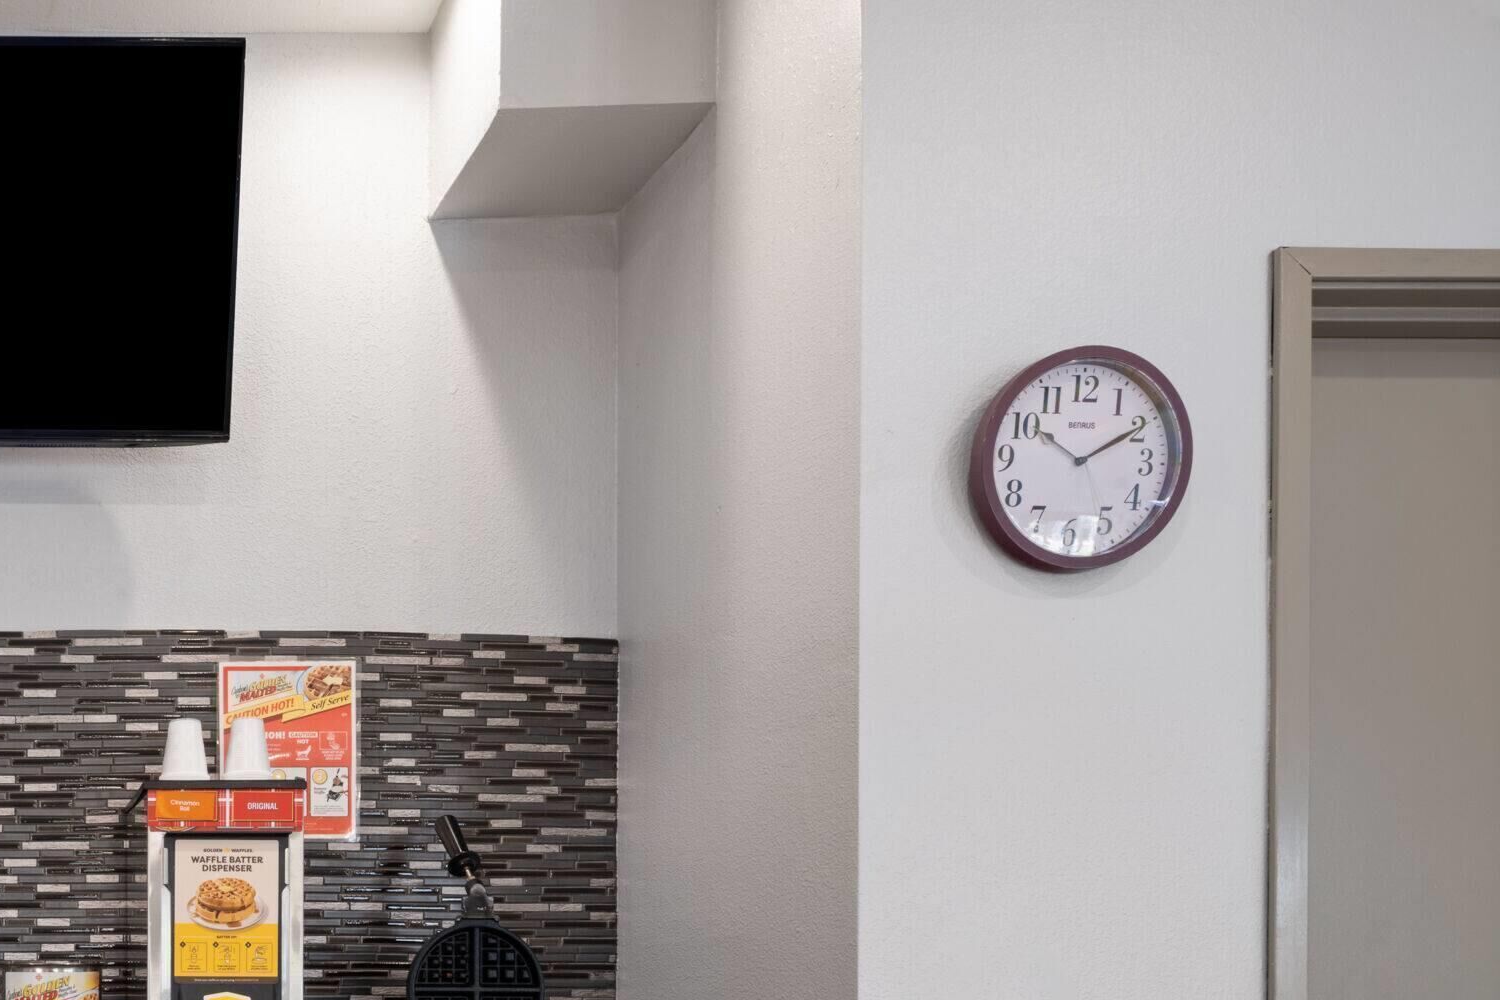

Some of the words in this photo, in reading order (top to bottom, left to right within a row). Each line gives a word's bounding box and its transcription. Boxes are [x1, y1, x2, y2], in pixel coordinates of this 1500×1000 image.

[1040, 386, 1062, 414] 11
[1071, 374, 1099, 403] 12
[1112, 388, 1123, 416] 1
[1011, 411, 1040, 440] 10
[1068, 421, 1096, 430] BENRUS
[1129, 415, 1147, 443] 2
[997, 444, 1015, 472] 9
[1138, 448, 1153, 476] 3
[1004, 479, 1023, 507] 8
[1123, 483, 1141, 511] 4
[1030, 505, 1047, 534] 7
[1062, 518, 1077, 547] 6
[1097, 506, 1113, 535] 5
[271, 698, 294, 712] HOT!
[311, 701, 326, 711] Self
[328, 695, 349, 706] Serve
[170, 799, 200, 807] Cinnamon
[247, 802, 278, 810] ORIGINAL
[191, 856, 228, 864] WAFFLE
[229, 856, 264, 864] BATTER
[202, 864, 252, 872] DISPENSER
